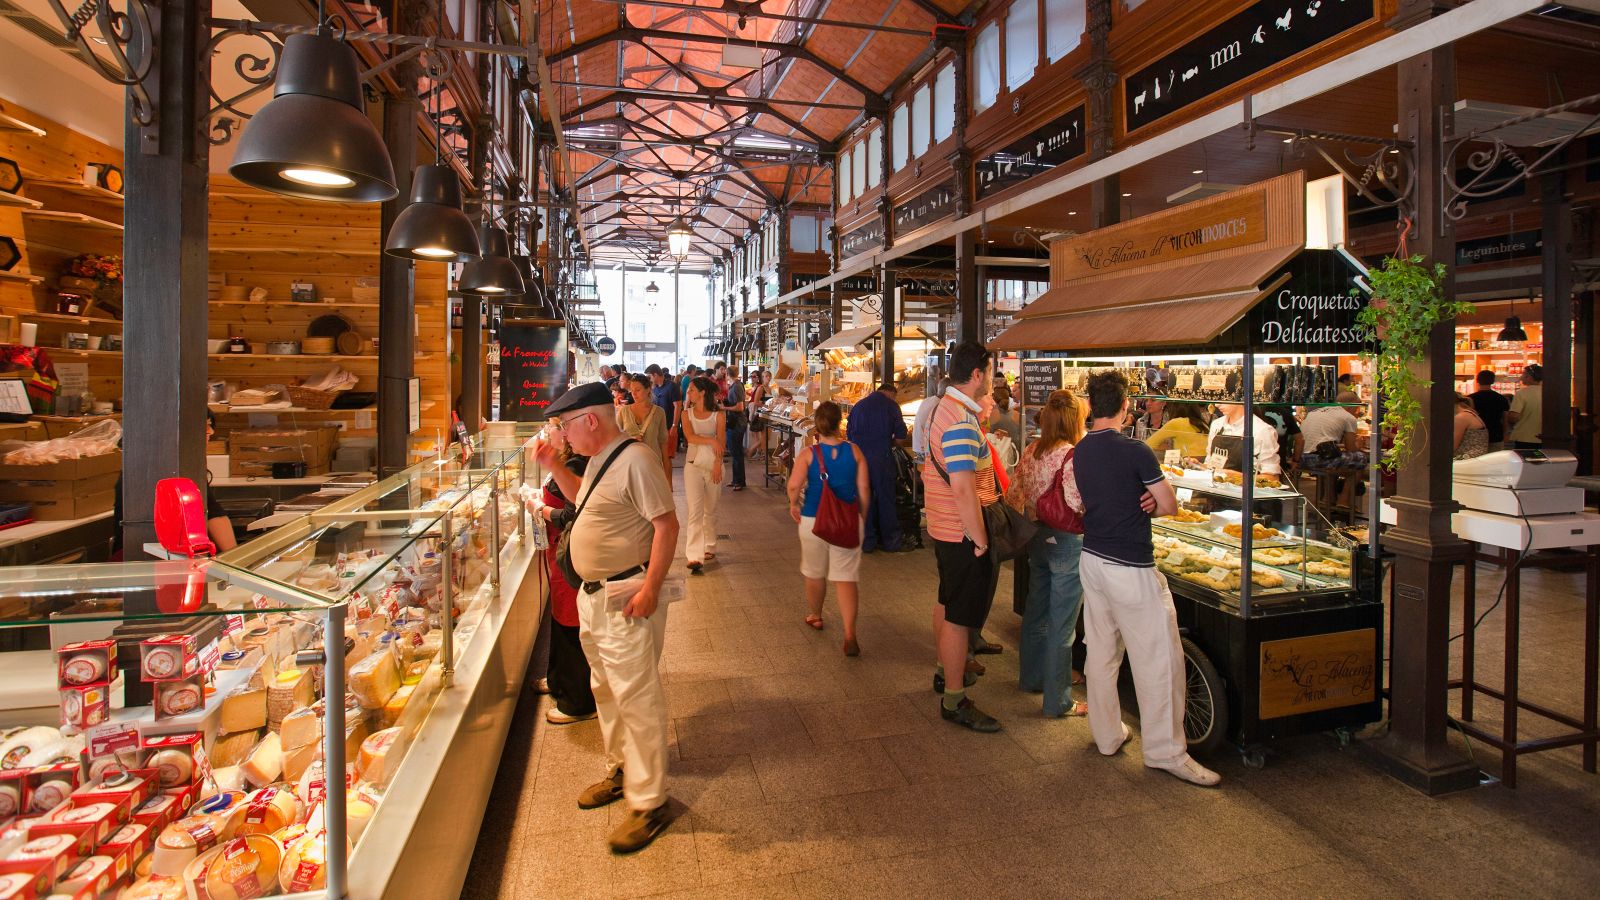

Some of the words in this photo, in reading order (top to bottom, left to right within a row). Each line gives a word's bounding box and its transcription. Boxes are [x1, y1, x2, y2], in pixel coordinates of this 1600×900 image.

[1461, 242, 1526, 259] Legumbres
[1278, 289, 1361, 320] Croquetas
[1261, 315, 1370, 344] Delicatesse
